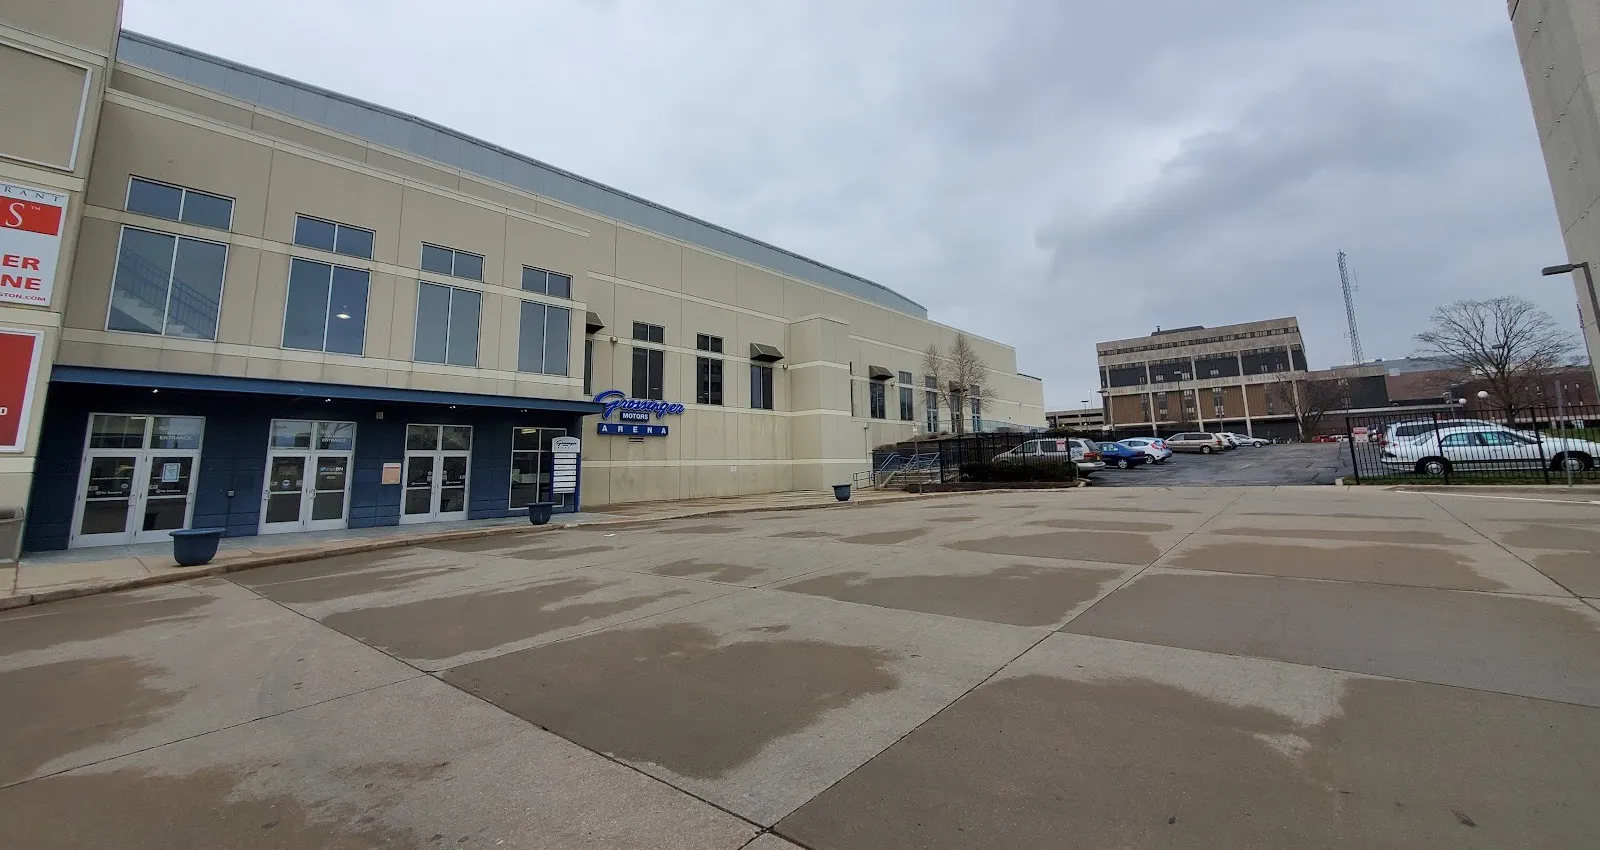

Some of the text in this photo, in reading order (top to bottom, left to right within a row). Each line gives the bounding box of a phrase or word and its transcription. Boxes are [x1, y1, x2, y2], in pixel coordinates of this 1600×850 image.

[4, 186, 61, 202] RANT
[2, 254, 40, 271] ER
[0, 273, 41, 291] NE
[593, 390, 685, 419] Grossinger
[622, 412, 649, 420] MOTORS
[601, 424, 667, 434] ARENA
